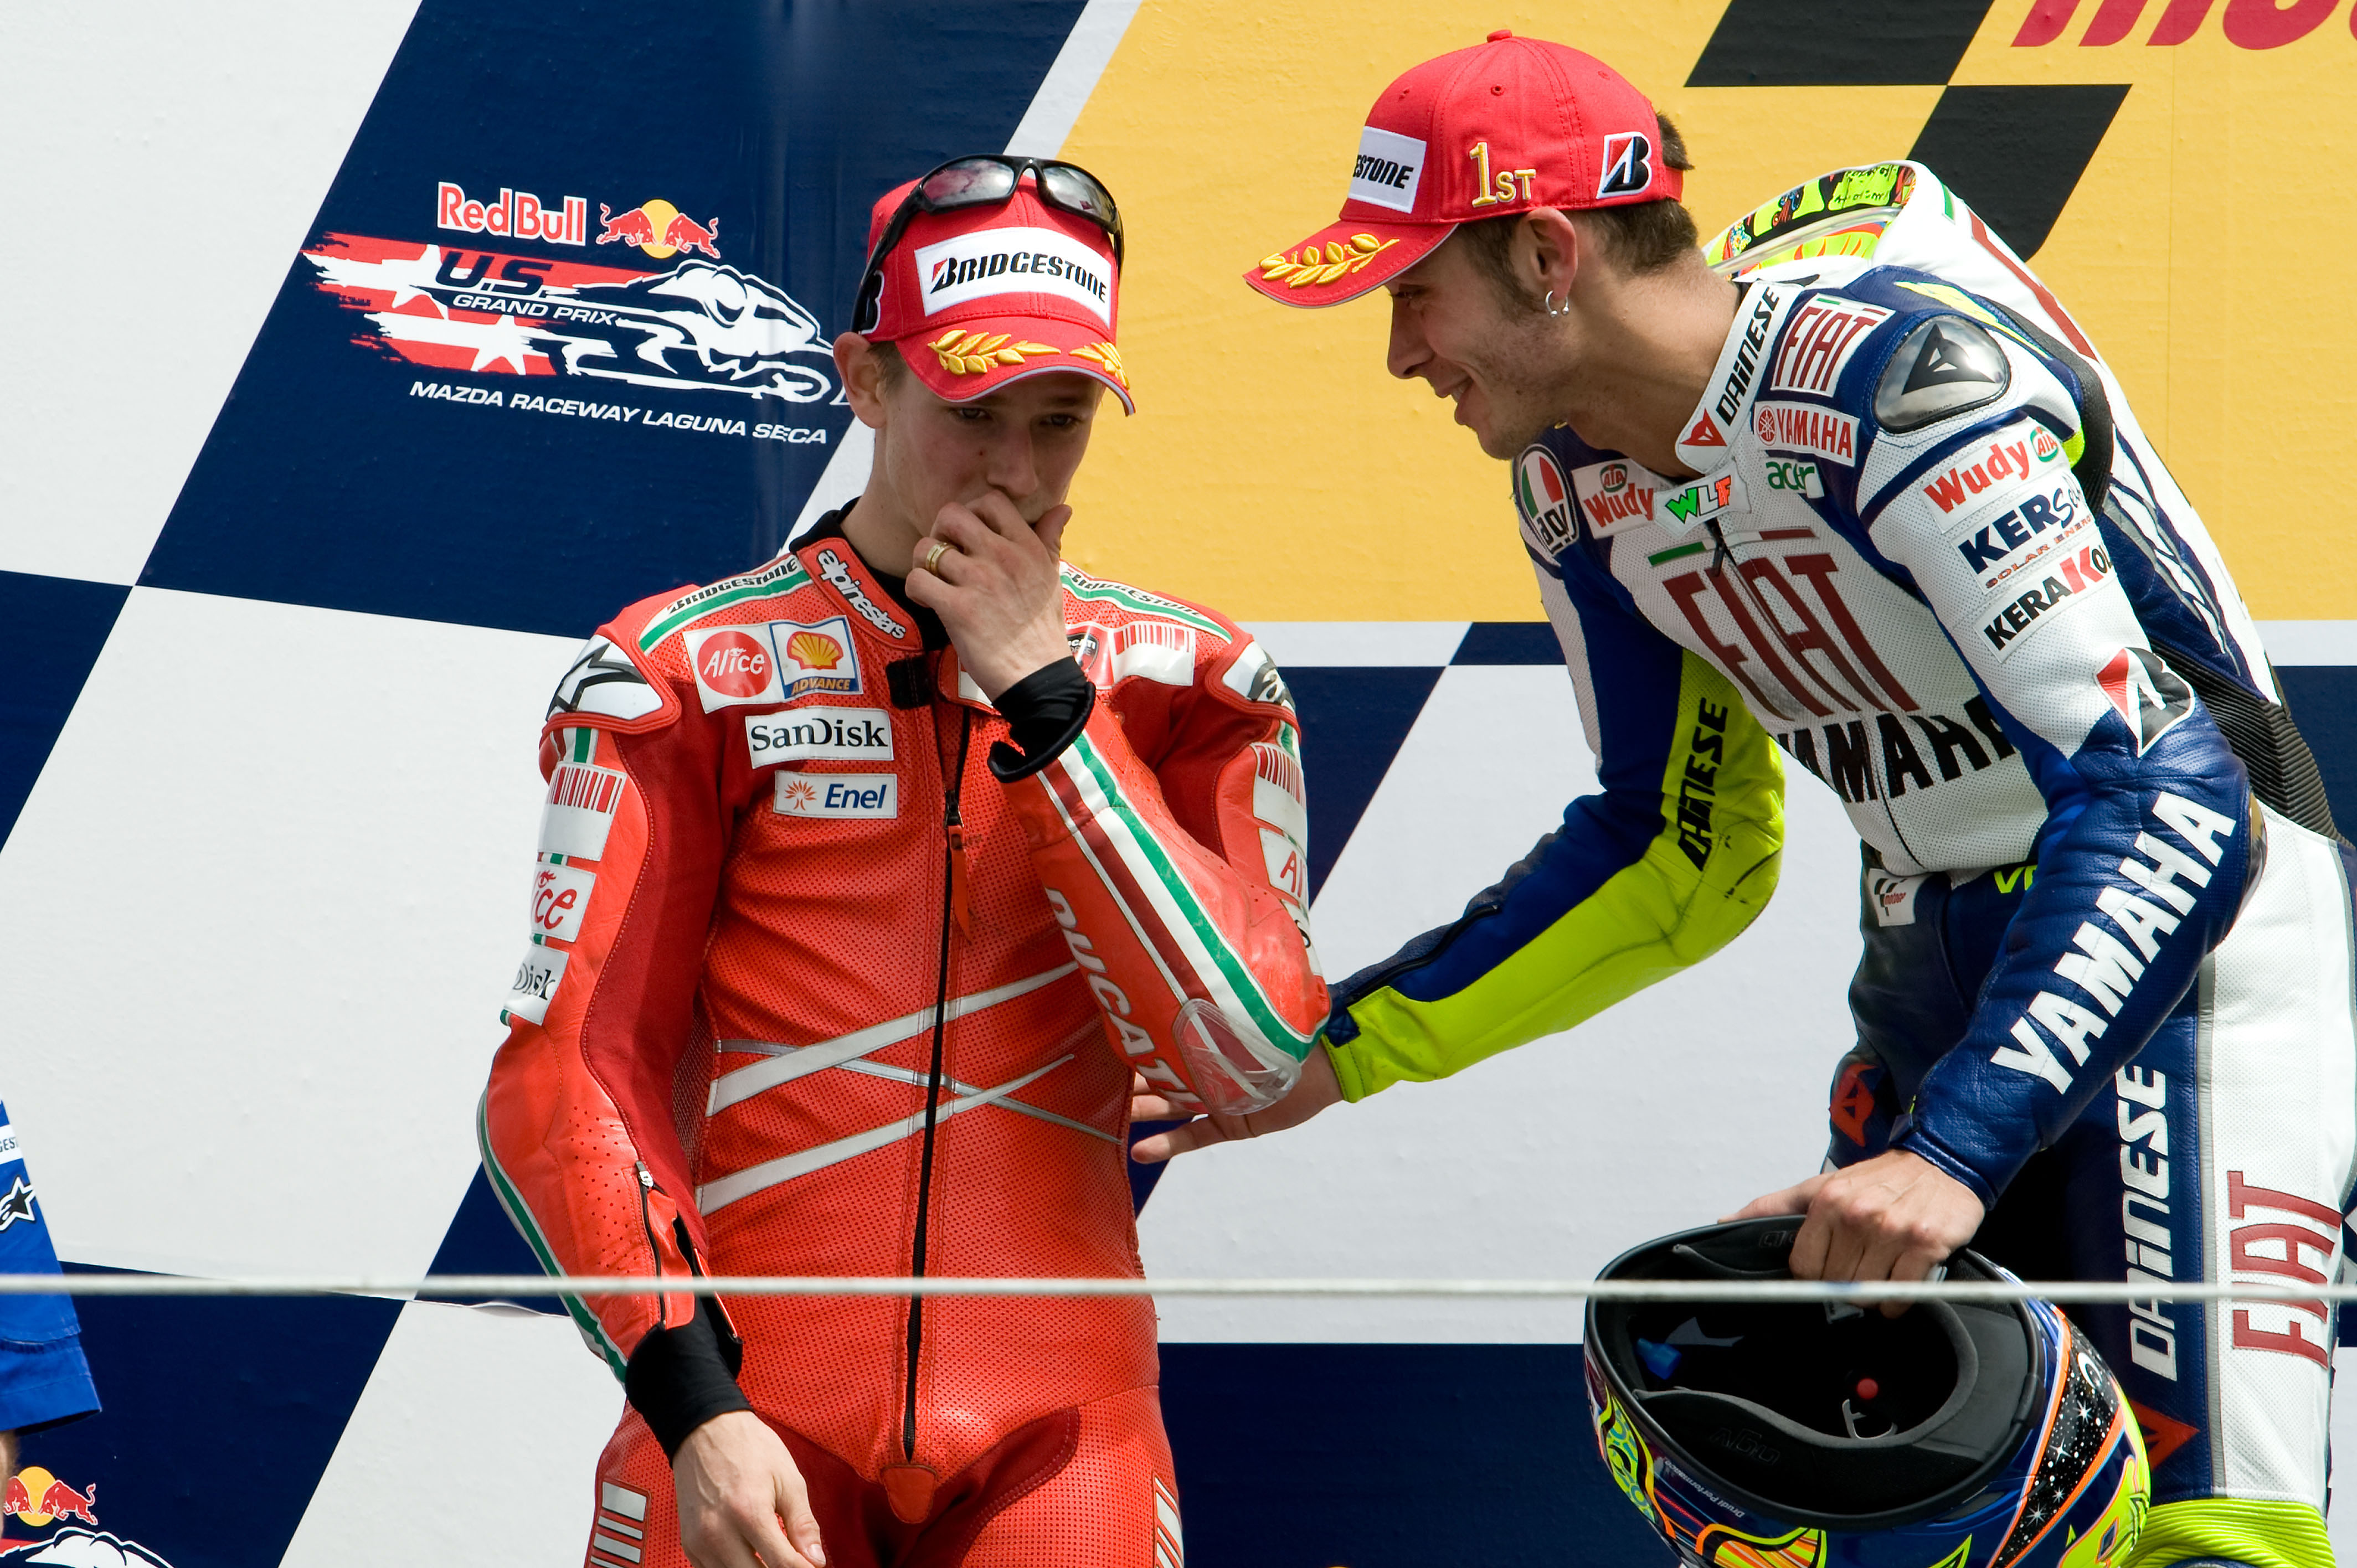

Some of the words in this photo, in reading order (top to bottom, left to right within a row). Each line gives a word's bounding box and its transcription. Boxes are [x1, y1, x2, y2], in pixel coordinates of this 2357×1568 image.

[1469, 142, 1536, 208] 1ST
[438, 181, 511, 235] Red
[515, 190, 587, 246] Bull
[930, 252, 1107, 304] BRIDGESTONE
[452, 293, 549, 318] GRAND
[552, 305, 621, 326] PRIX
[1775, 306, 1879, 391] FIAT
[409, 380, 505, 408] MAZDA
[509, 392, 640, 424] RACEWAY
[642, 409, 748, 437] LAGUNA
[751, 423, 827, 445] SECA
[1777, 408, 1853, 460] YAMAHA
[1583, 483, 1654, 528] Wudy
[1922, 439, 2030, 514] Wudy
[667, 557, 799, 615] BRIDGESTONE
[816, 549, 907, 640] alpinestars
[1985, 542, 2051, 589] SOLAR
[703, 646, 766, 679] Alice
[1661, 553, 1920, 721] FIAT
[791, 677, 852, 697] ADVANCE
[750, 717, 889, 752] SanDisk
[824, 782, 887, 811] Enel
[1990, 791, 2237, 1095] YAMAHA
[1044, 887, 1203, 1103] DUCATI
[2227, 1170, 2344, 1370] FIAT
